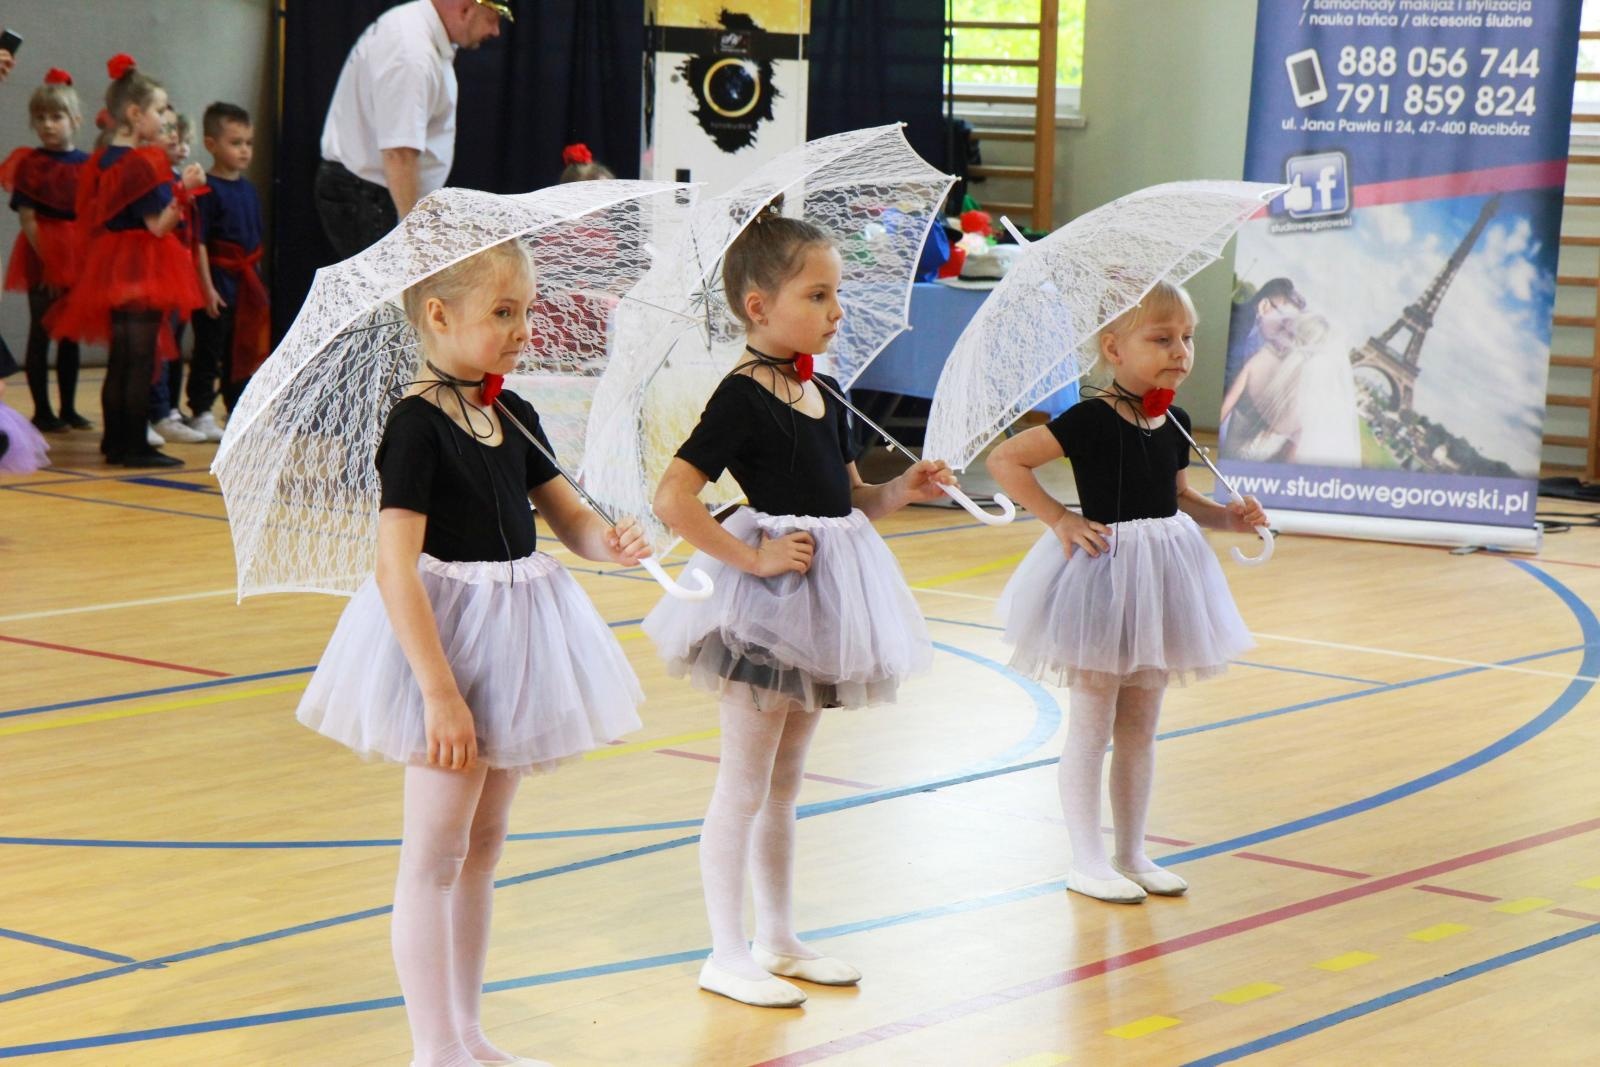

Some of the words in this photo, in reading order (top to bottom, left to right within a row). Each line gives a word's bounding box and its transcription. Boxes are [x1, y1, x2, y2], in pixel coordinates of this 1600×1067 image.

[1465, 0, 1532, 13] stylizacja
[1309, 13, 1354, 26] nauka
[1412, 14, 1482, 27] akcesoria
[1485, 13, 1533, 28] ślubne
[1338, 46, 1397, 77] 888
[1407, 48, 1468, 78] 056
[1480, 49, 1540, 79] 744
[1336, 84, 1390, 114] 791
[1403, 86, 1465, 116] 859
[1474, 87, 1536, 117] 824
[1281, 117, 1297, 131] ul.
[1300, 117, 1335, 132] Jana
[1338, 118, 1381, 133] Pawła
[1395, 120, 1415, 135] 24,
[1419, 120, 1466, 135] 47-400
[1469, 121, 1531, 136] Racibórz
[1223, 475, 1529, 515] www.studiowegorowski.pl
